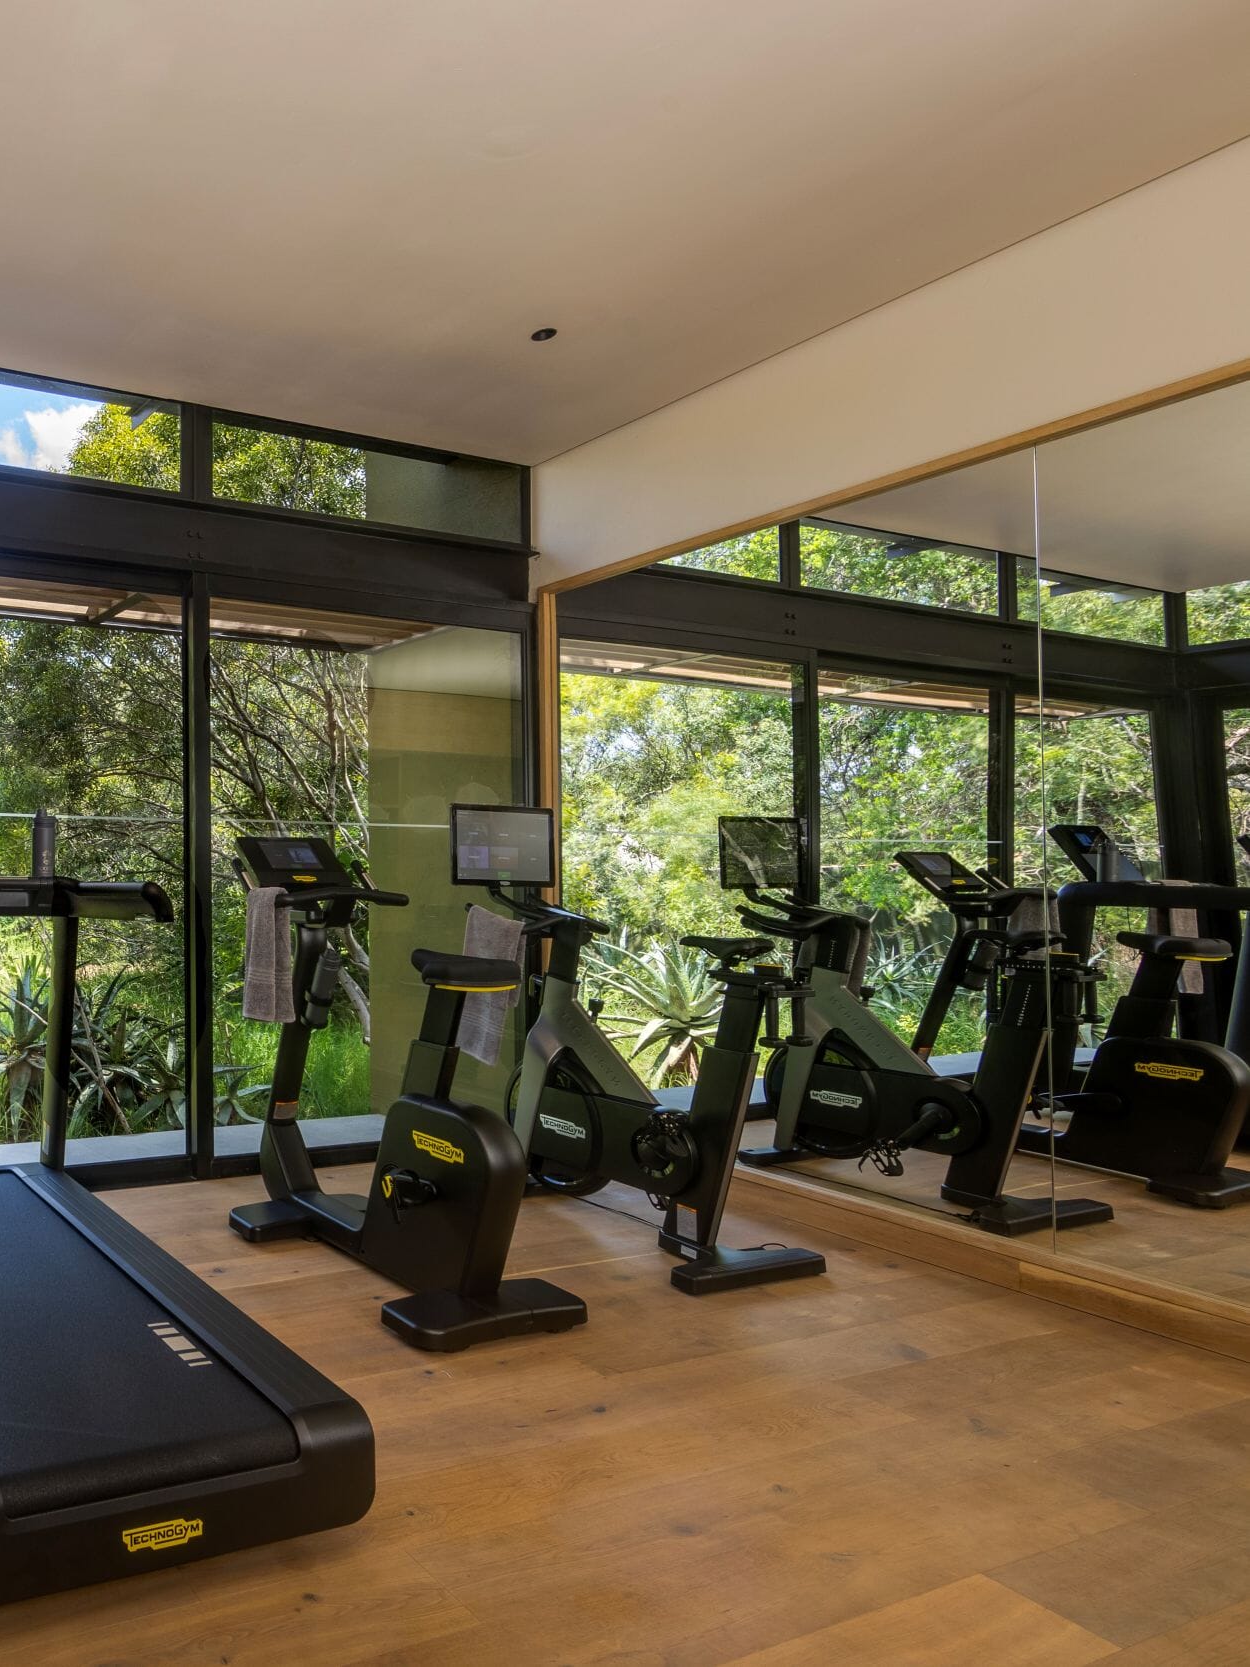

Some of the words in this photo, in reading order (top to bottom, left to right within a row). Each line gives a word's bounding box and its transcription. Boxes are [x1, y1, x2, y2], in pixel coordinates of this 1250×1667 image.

[541, 1115, 584, 1136] TECHNOGYM
[413, 1132, 463, 1159] TECHNOGYM
[124, 1522, 201, 1548] TECHNOGYM
